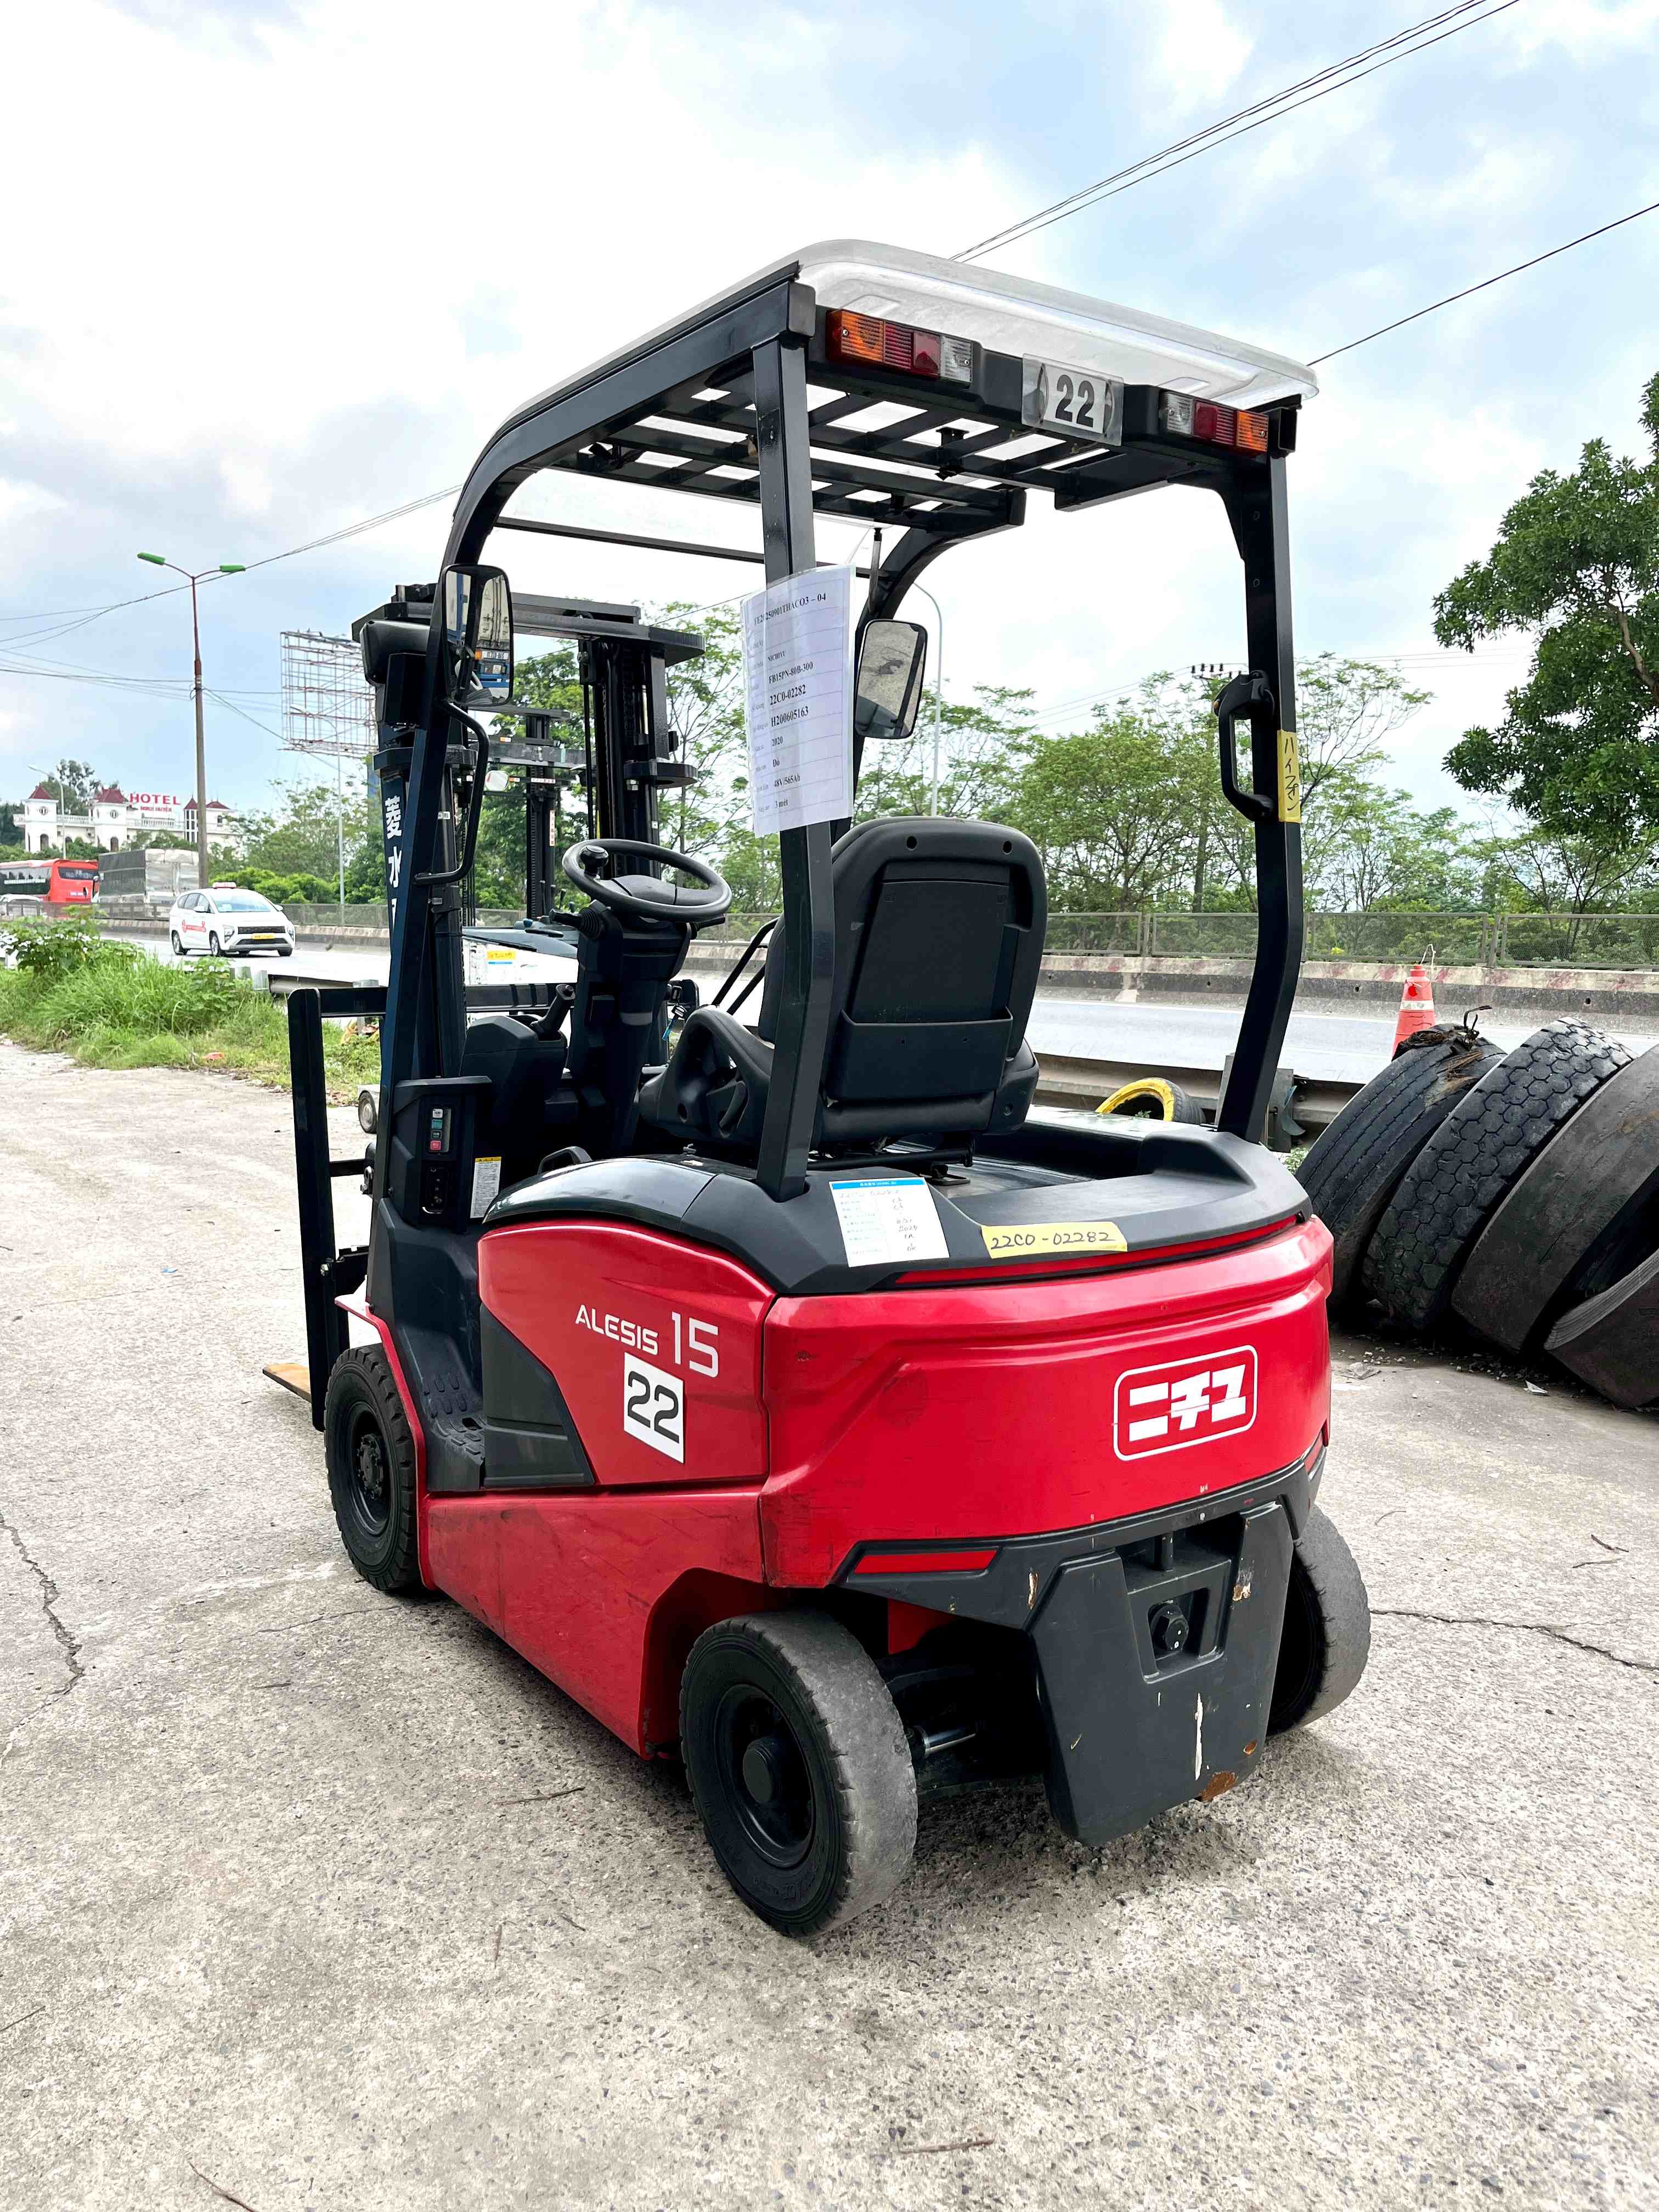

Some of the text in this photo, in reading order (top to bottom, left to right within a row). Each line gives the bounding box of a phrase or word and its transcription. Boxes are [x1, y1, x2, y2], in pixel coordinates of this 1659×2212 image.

[1054, 374, 1095, 428] 22
[817, 592, 826, 602] 04
[772, 736, 783, 747] 2020
[129, 793, 180, 805] HOTEL
[575, 1304, 719, 1378] ALESIS 15
[627, 1370, 680, 1444] 22
